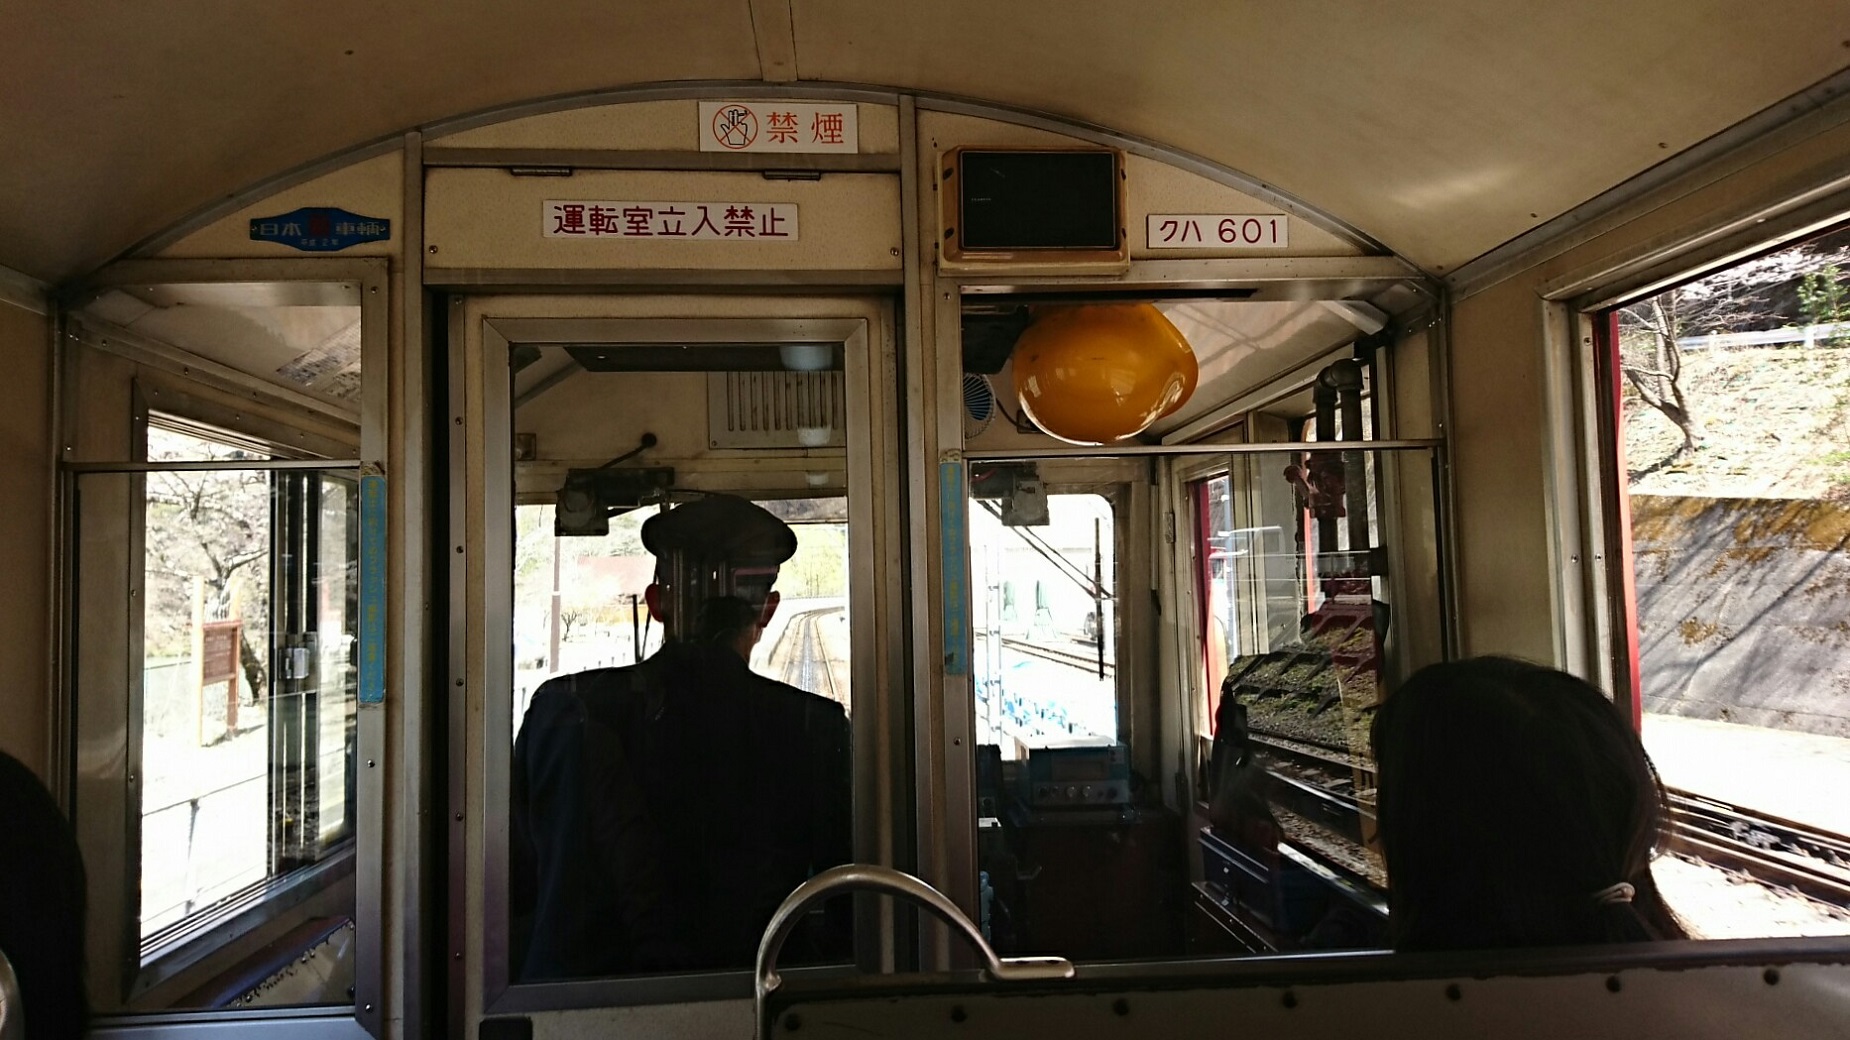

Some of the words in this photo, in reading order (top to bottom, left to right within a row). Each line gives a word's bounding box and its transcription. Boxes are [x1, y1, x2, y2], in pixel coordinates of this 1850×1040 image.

[766, 111, 844, 144] 禁煙
[260, 222, 302, 236] 日本
[553, 204, 789, 237] 運転室立入禁止
[1159, 220, 1202, 242] クハ
[1218, 218, 1277, 243] 601
